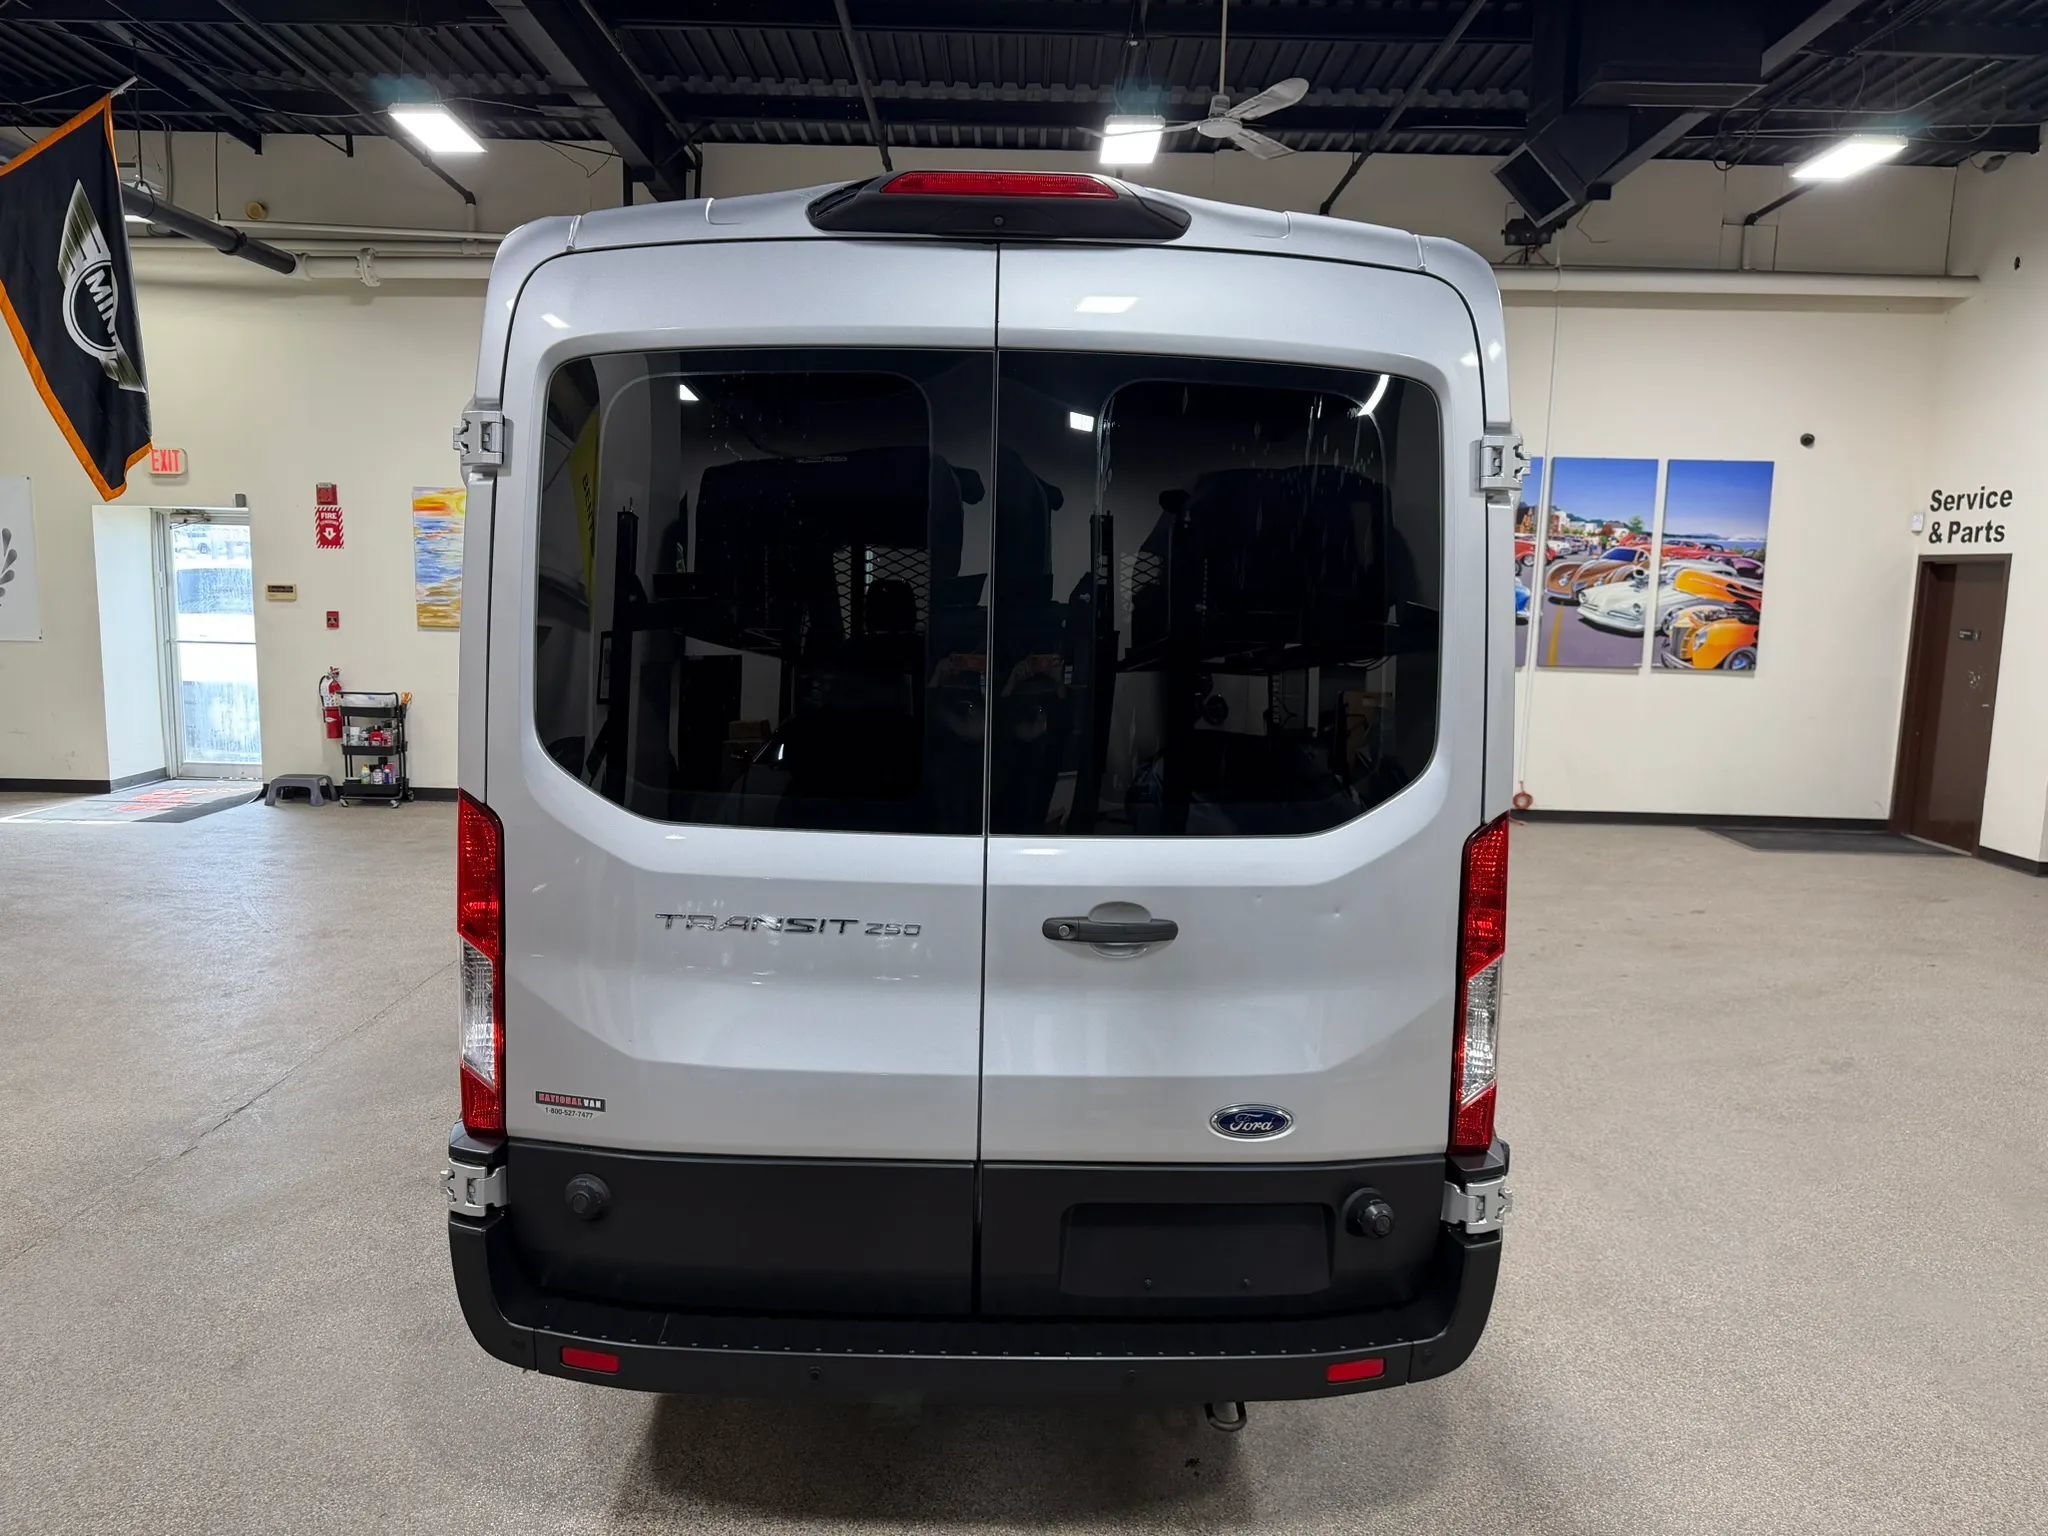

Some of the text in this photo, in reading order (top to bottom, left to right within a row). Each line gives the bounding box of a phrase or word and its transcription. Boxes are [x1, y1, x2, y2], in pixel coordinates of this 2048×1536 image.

[151, 449, 180, 472] EXIT
[1929, 486, 2013, 512] Service
[320, 511, 338, 520] FIRE
[1928, 520, 2006, 544] & Parts
[655, 913, 922, 937] TRANSIT 250
[538, 1093, 602, 1109] NATIONAL VAN
[545, 1106, 594, 1119] 1-800-527-7477
[1229, 1112, 1274, 1132] Ford
